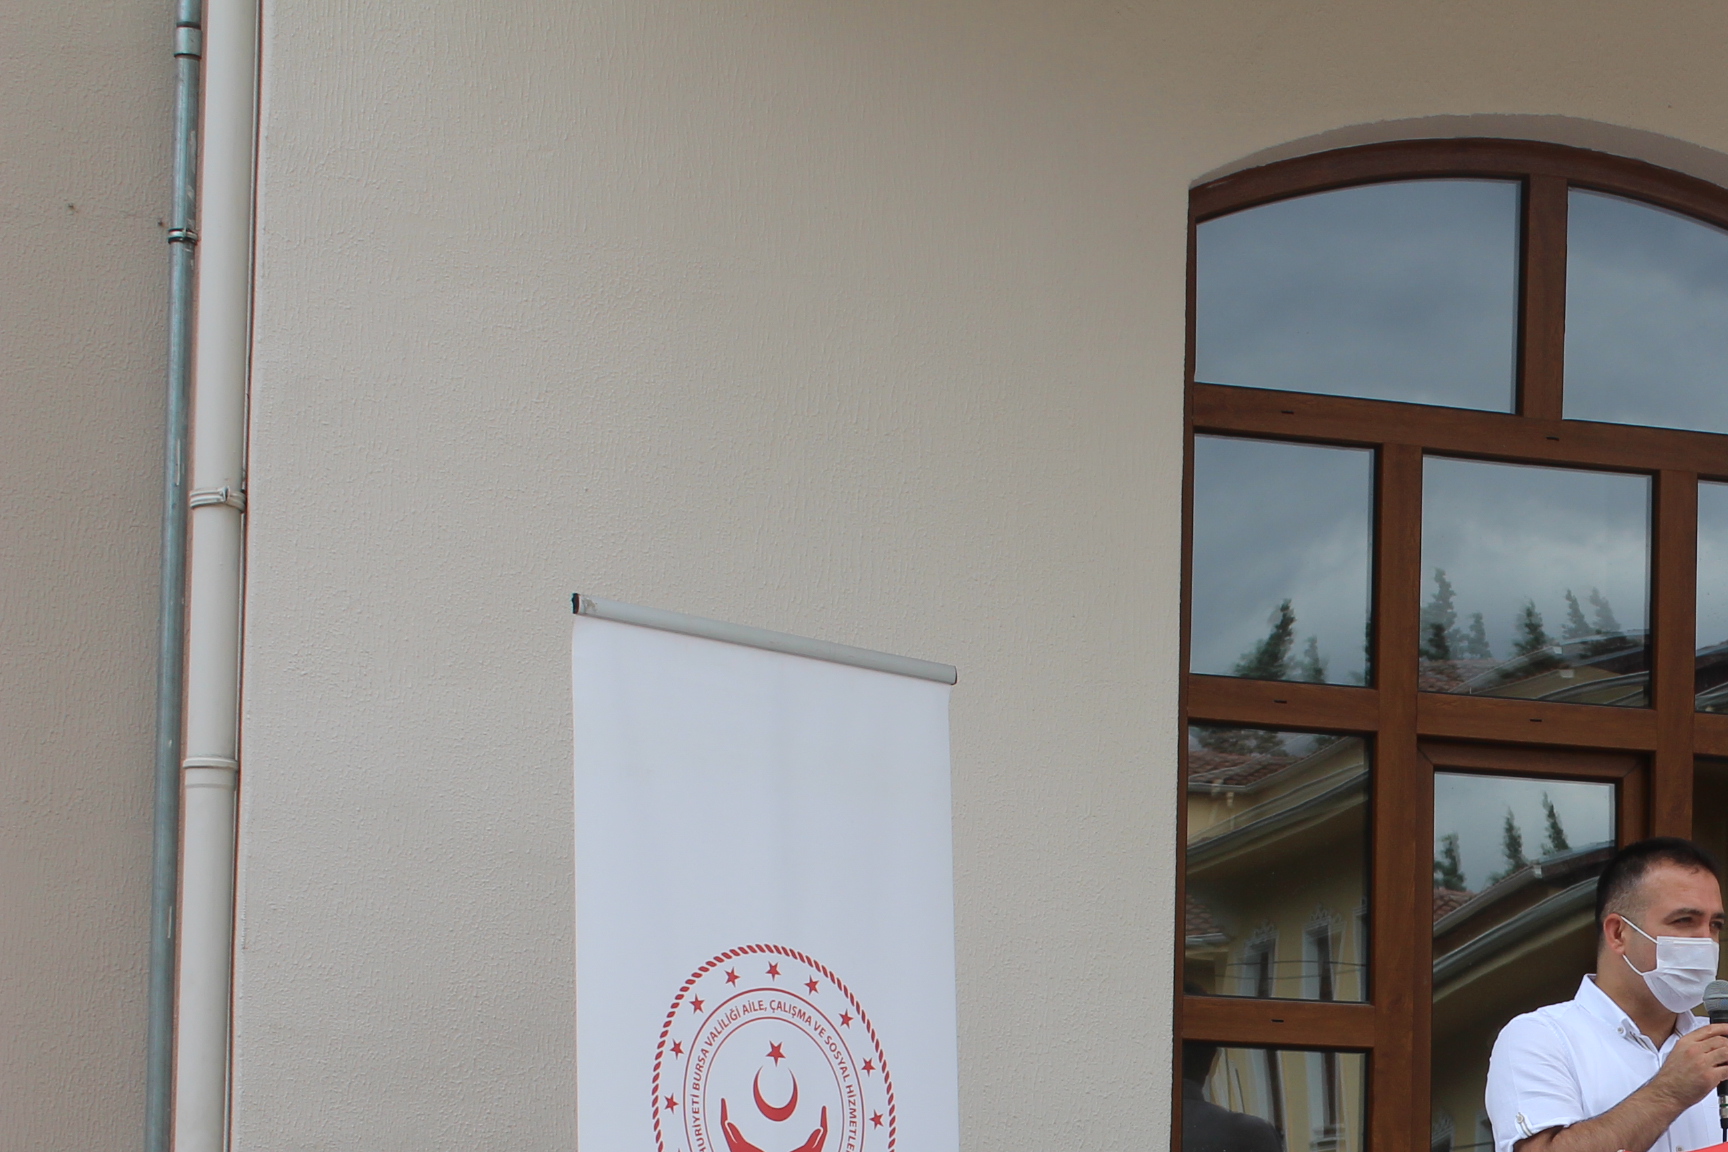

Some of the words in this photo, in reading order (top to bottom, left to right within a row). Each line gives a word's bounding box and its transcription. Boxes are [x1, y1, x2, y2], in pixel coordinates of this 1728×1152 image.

[692, 1048, 709, 1091] BURSA
[704, 1006, 741, 1046] VALİLİĞİ
[743, 1000, 767, 1015] AİLE,
[770, 1000, 812, 1026] ÇALIŞMA
[814, 1021, 826, 1038] VE
[824, 1036, 850, 1082] SOSYAL
